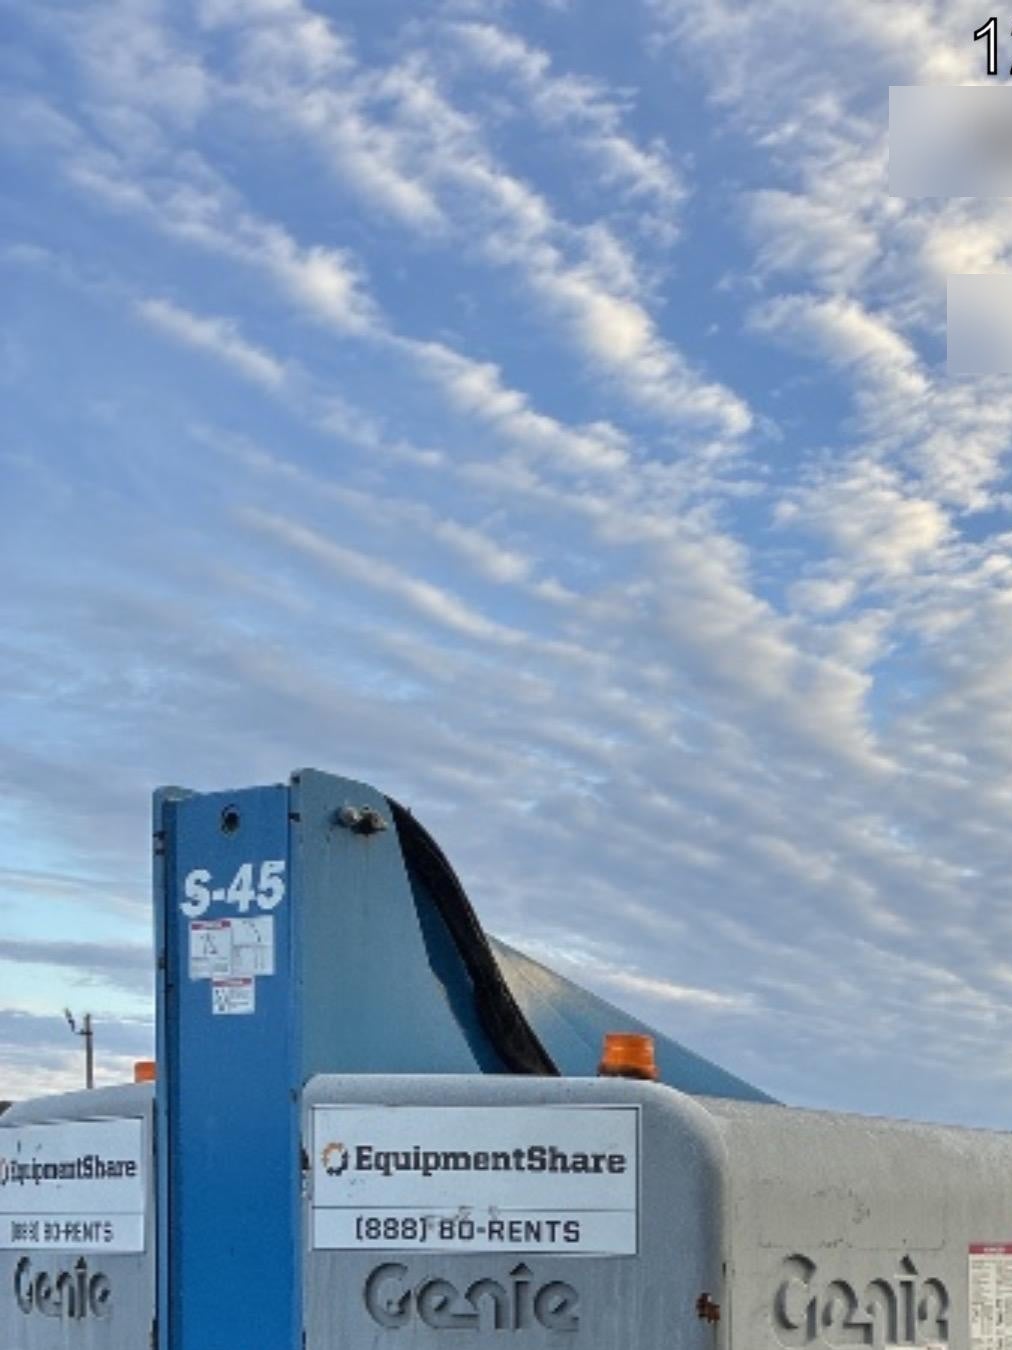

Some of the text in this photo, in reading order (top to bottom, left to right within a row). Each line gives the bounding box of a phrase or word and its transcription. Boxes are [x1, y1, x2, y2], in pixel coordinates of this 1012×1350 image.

[179, 860, 285, 918] S-45
[355, 1146, 627, 1176] EquipmentShare
[14, 1256, 111, 1320] Genie
[364, 1262, 580, 1331] Genie
[772, 1252, 950, 1350] Genie
